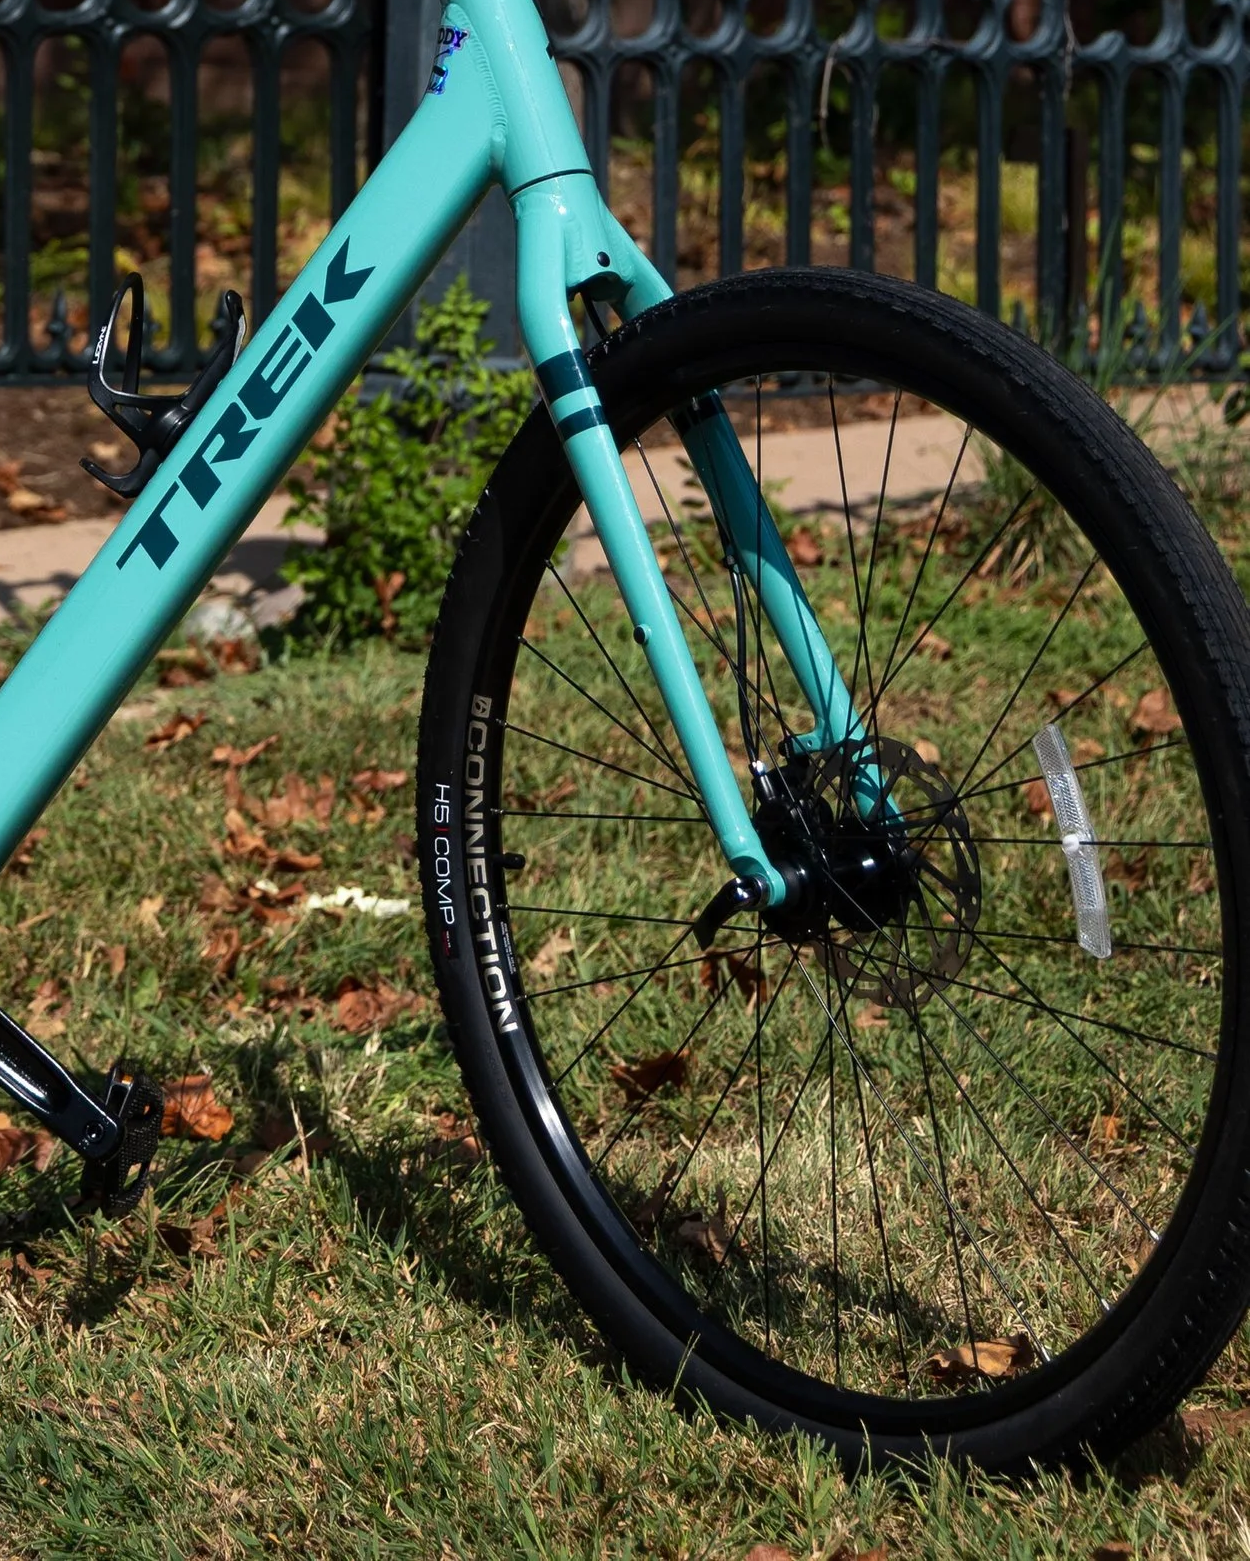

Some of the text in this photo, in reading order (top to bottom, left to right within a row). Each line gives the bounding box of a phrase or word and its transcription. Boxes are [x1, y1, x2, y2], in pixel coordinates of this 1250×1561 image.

[115, 234, 377, 571] TREK
[434, 783, 451, 824] H5
[434, 836, 455, 926] COMP
[463, 720, 518, 1034] CONNECTION
